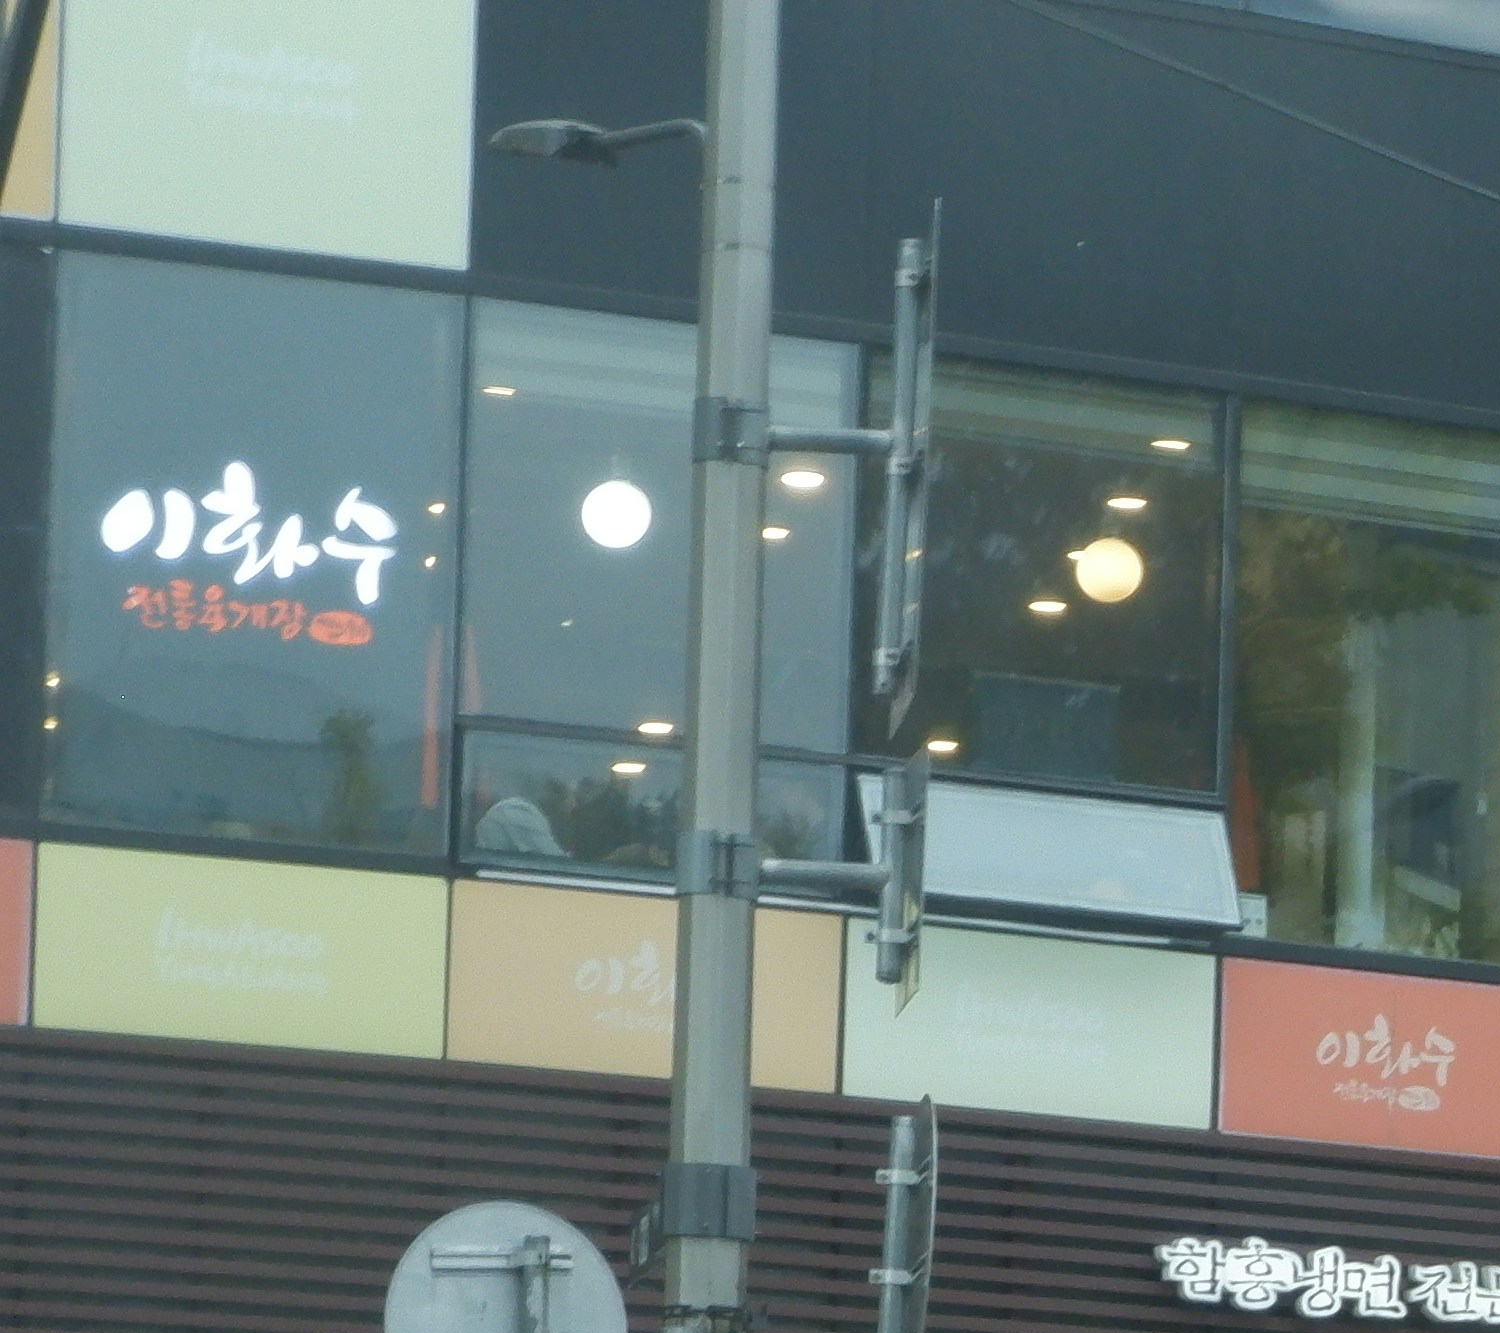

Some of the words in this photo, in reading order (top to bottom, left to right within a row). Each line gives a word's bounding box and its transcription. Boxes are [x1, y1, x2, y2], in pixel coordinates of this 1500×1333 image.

[100, 461, 399, 605] 이화수
[1315, 1013, 1457, 1087] 이화수
[1157, 1236, 1408, 1318] 함흥냉면
